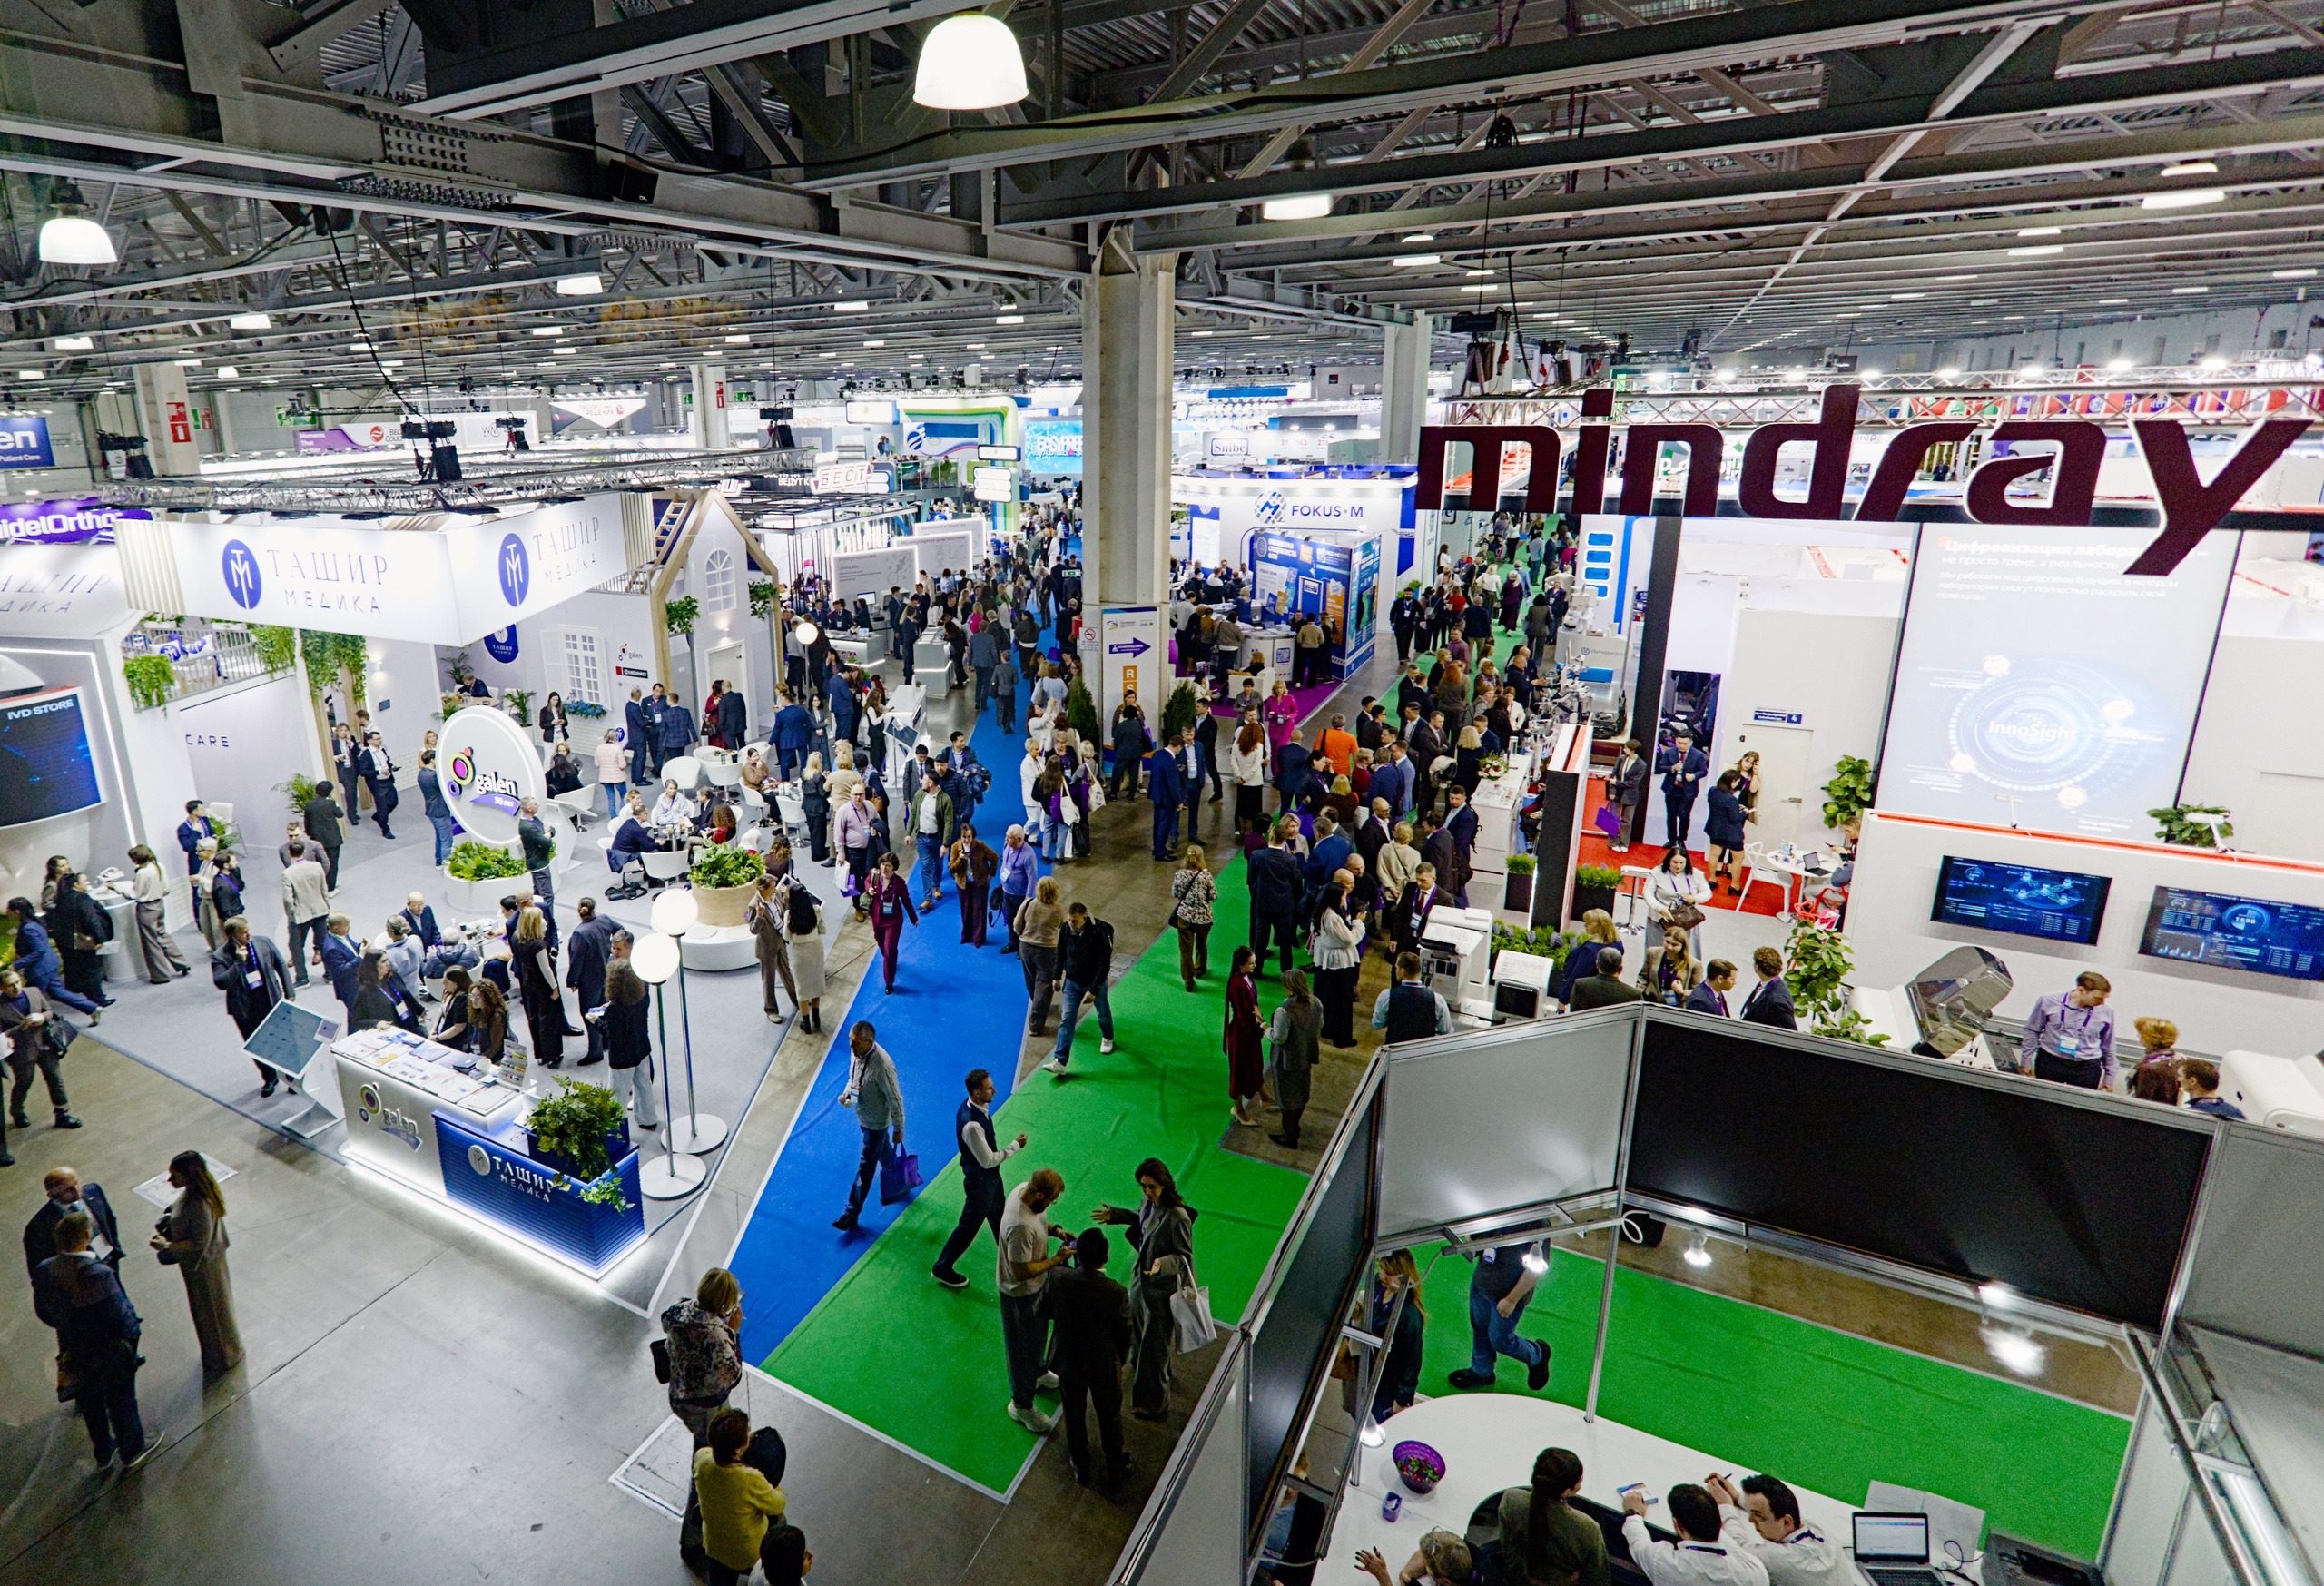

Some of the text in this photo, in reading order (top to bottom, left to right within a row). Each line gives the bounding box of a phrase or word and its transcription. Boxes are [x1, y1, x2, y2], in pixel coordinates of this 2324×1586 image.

[1214, 442, 1246, 453] Snibe
[822, 468, 864, 487] БЕСТ
[1415, 384, 2314, 576] mindray
[0, 511, 117, 539] idelOrtho
[533, 517, 599, 561] ТАШИР
[1945, 540, 2072, 556] Цифровизация
[267, 549, 388, 586] ТАШИР
[1958, 557, 1998, 566] просто
[2048, 559, 2118, 569] реальность
[1939, 571, 1955, 579] Мы
[1957, 572, 2002, 581] работаем
[2004, 574, 2021, 582] над
[2132, 579, 2178, 588] котором
[284, 589, 382, 615] МЕДИКА
[628, 651, 644, 659] galen
[1126, 668, 1135, 678] R
[7, 699, 74, 720] IVD STORE
[185, 734, 230, 748] CARE
[1988, 720, 2078, 742] InnoSight
[476, 772, 518, 796] galen
[383, 1108, 418, 1135] galen
[492, 1156, 556, 1193] ТАШИР
[500, 1174, 550, 1203] МЕДИКА
